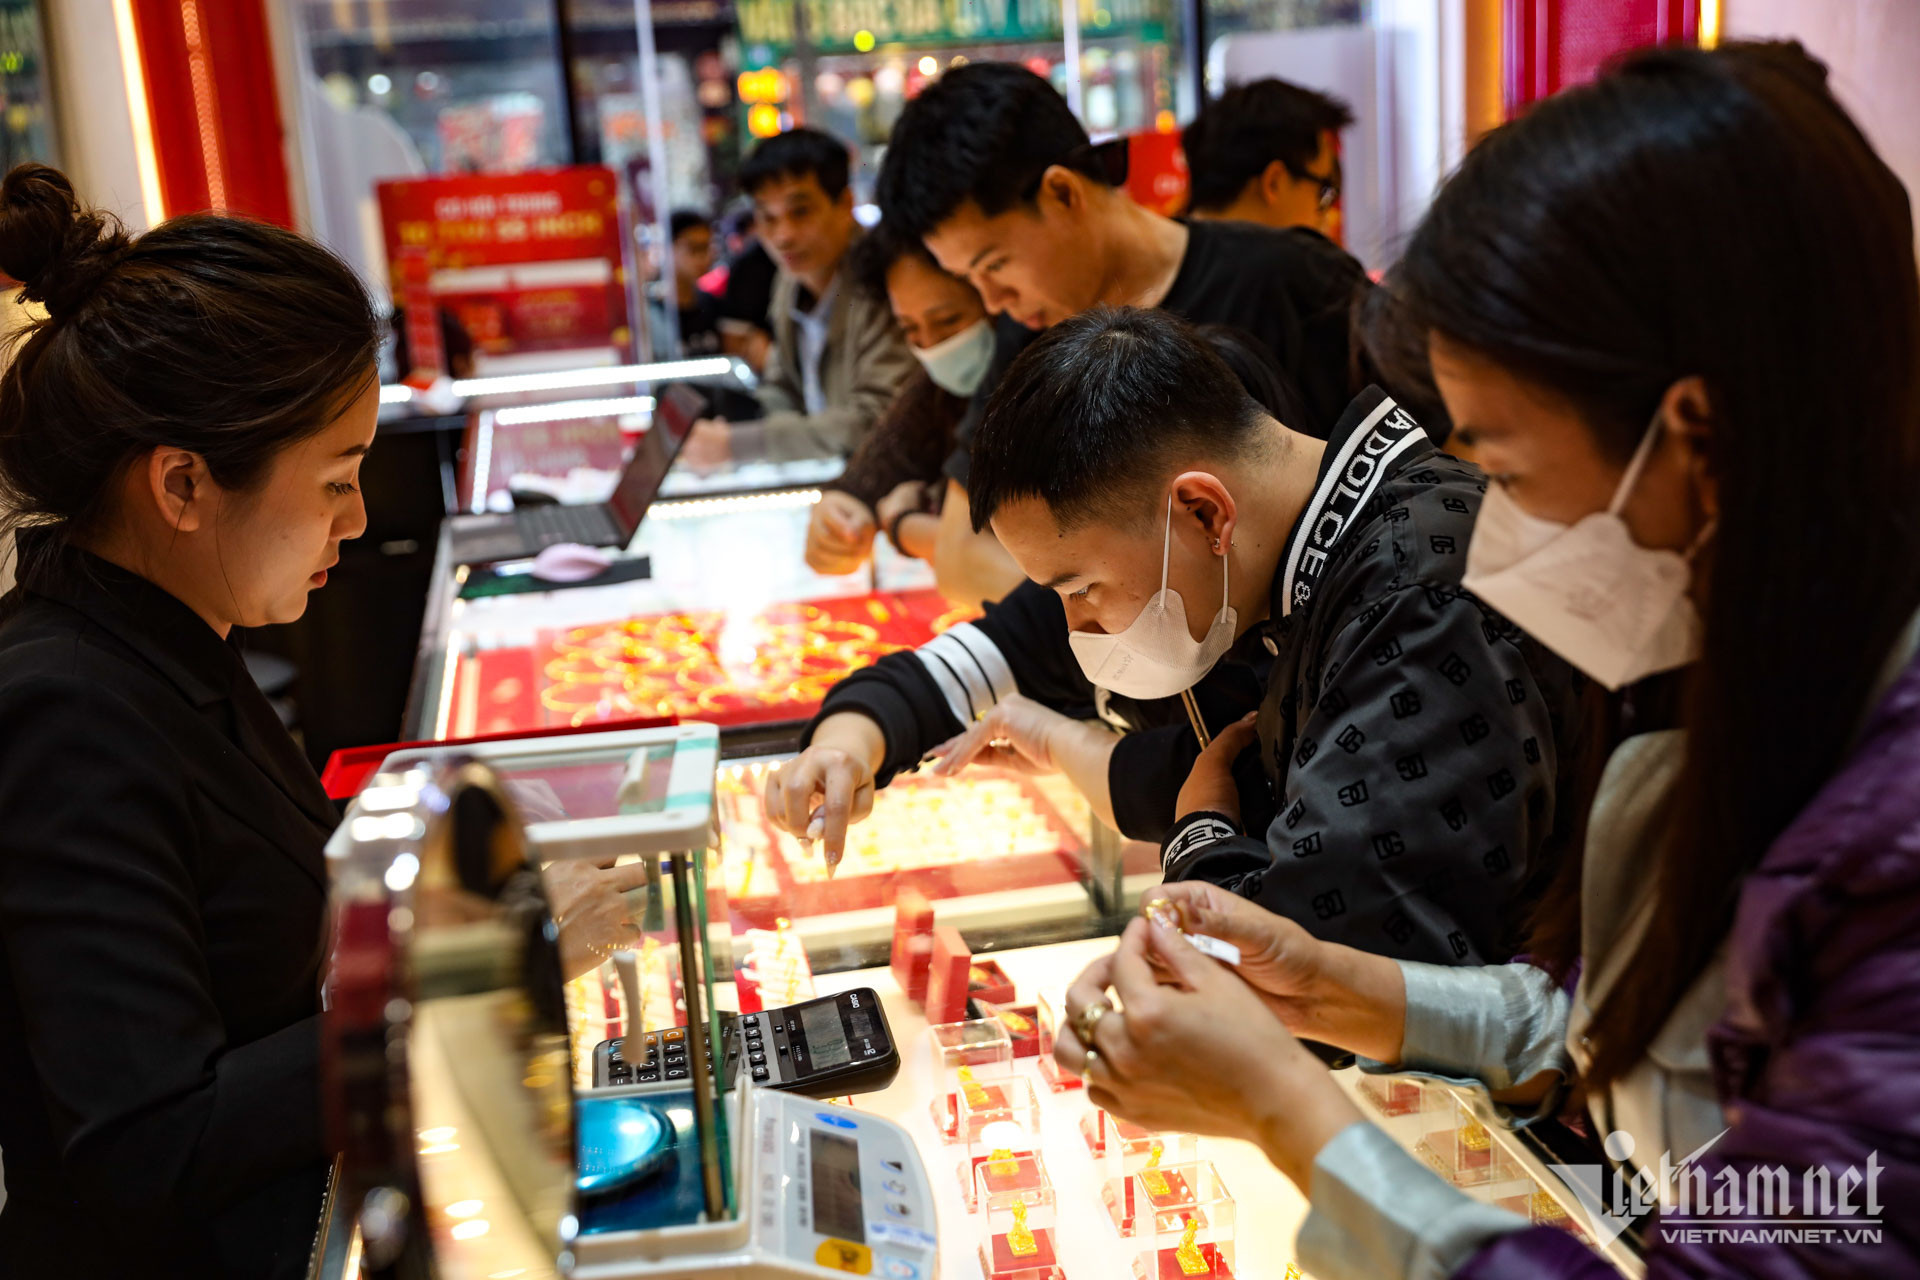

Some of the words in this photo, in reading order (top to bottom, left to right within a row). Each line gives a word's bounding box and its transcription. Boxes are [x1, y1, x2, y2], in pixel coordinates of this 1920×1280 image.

[1300, 430, 1396, 578] DOLCE
[1294, 580, 1311, 606] &
[850, 993, 860, 1008] CASIO
